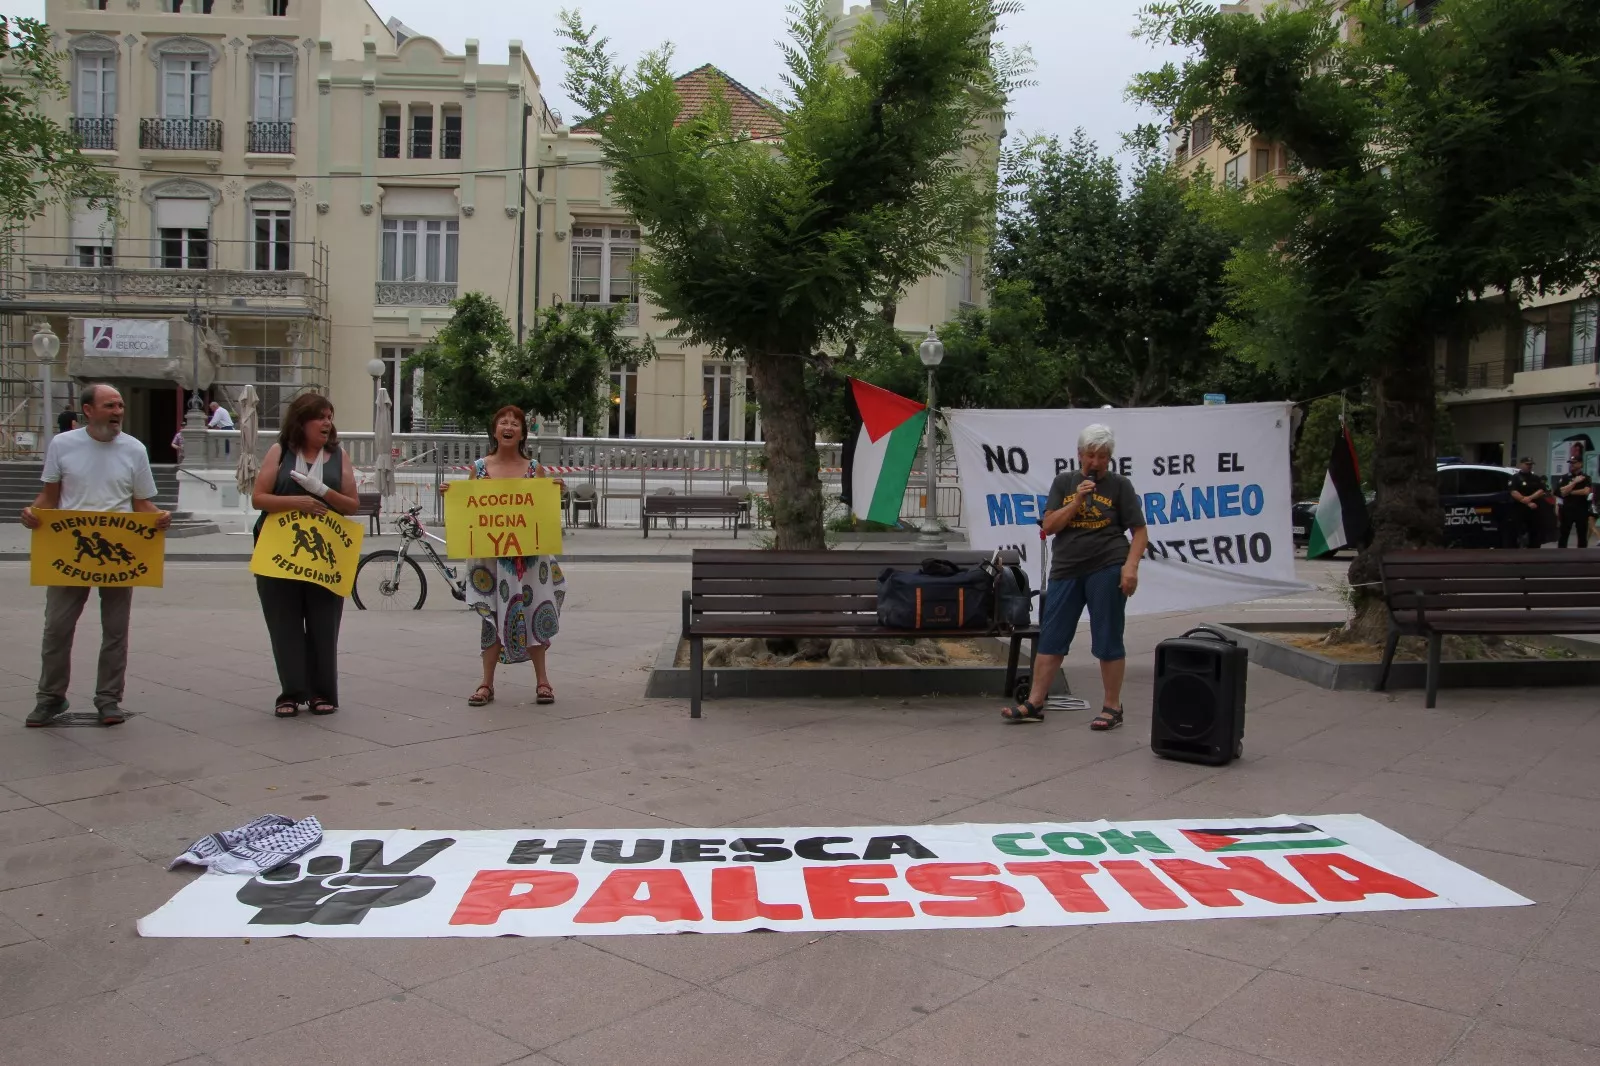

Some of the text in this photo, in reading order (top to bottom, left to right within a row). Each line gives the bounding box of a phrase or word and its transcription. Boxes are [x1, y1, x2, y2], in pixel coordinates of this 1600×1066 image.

[981, 443, 1245, 477] NO PUE SER EL
[466, 492, 535, 508] ACOGIDA
[986, 483, 1265, 527] MERÁNEO
[1445, 507, 1477, 516] ICIA
[50, 515, 158, 540] BIENVENIDXS
[478, 513, 527, 528] DIGNA
[1445, 515, 1491, 526] IONAL
[998, 543, 1027, 561] N
[1145, 532, 1272, 566] NTERIO
[51, 558, 149, 584] REFUGIADXS
[271, 554, 342, 585] REFUGIADXS
[507, 826, 1174, 865] HUESCA CON
[448, 852, 1439, 926] PALESTINA
